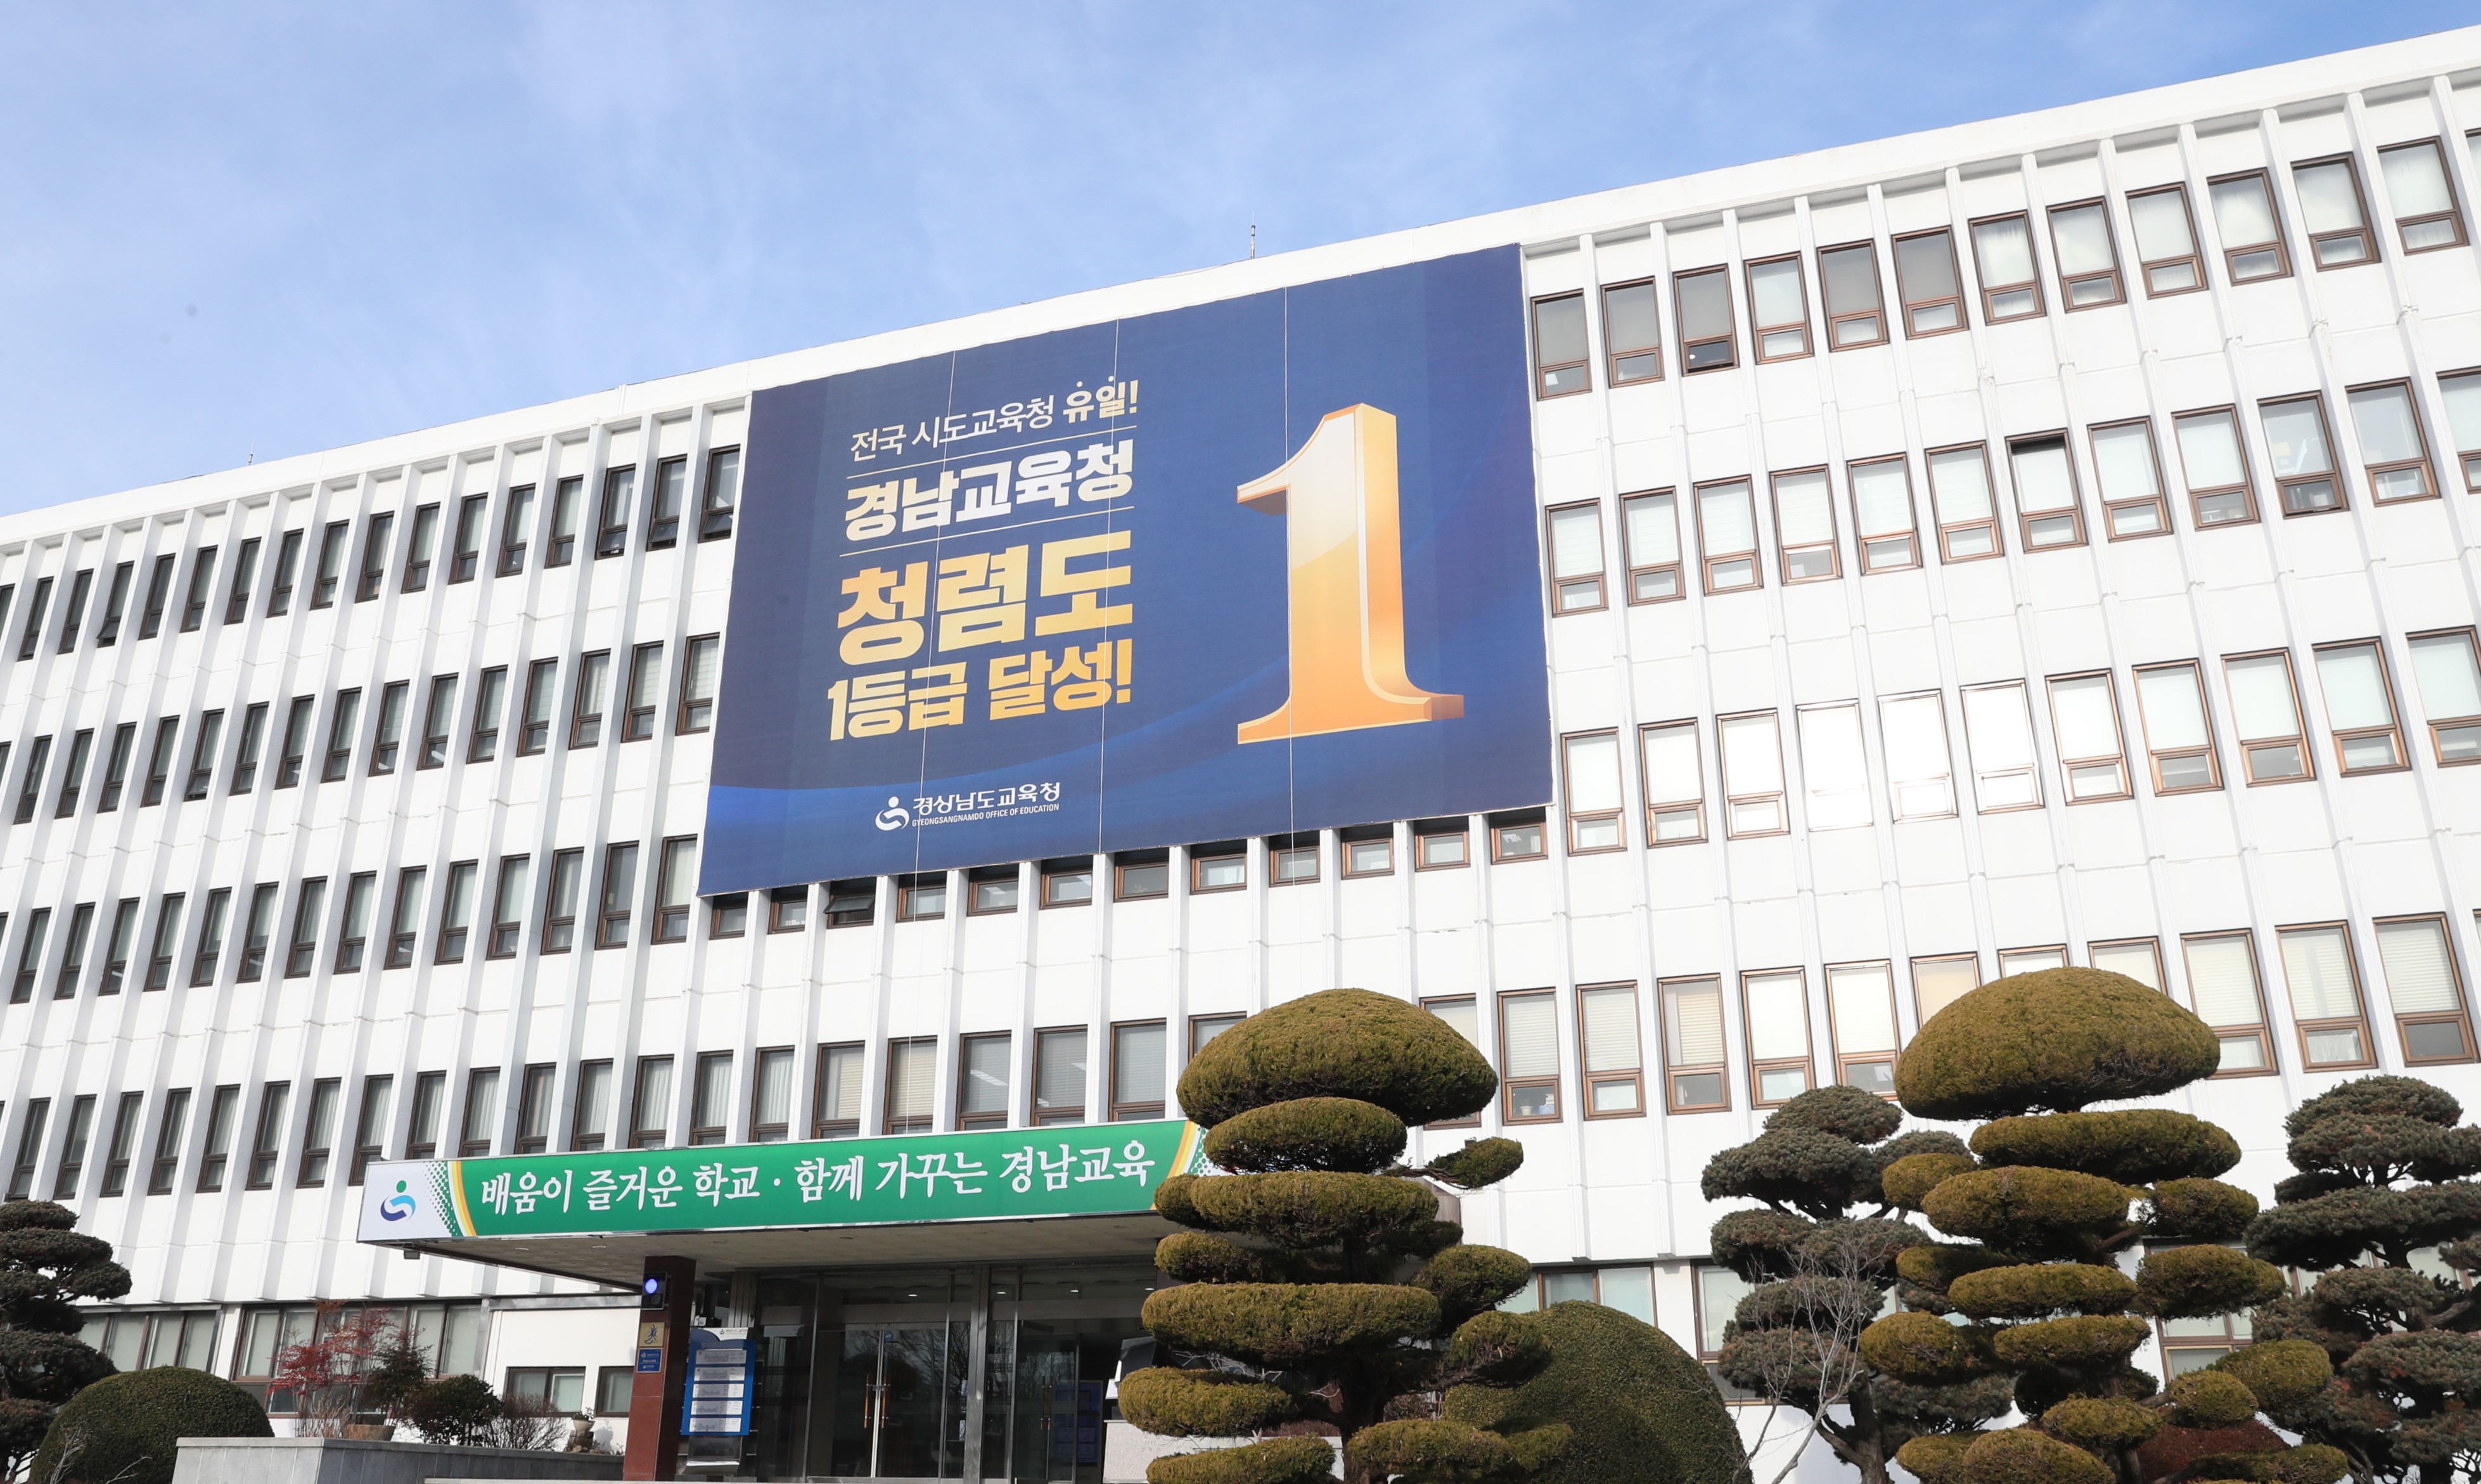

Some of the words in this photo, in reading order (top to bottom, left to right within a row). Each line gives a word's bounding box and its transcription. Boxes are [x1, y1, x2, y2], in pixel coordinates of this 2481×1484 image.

[851, 425, 906, 461] 전국
[912, 395, 1054, 449] 시도교육청
[1063, 376, 1139, 423] 유일!
[845, 439, 1133, 541] 경남교육청
[837, 530, 1133, 665] 청렴도
[1237, 402, 1464, 745] 1
[828, 662, 968, 741] 1등급
[989, 638, 1132, 720] 달성!
[912, 812, 984, 827] GYEONGSANGNAMDO
[985, 808, 1008, 819] OFFICE
[1010, 806, 1019, 816] OF
[1020, 803, 1060, 815] EDUCATION
[913, 782, 1060, 816] 경상남도교육청
[482, 1169, 574, 1215] 배움이
[582, 1165, 683, 1212] 즐거운
[693, 1162, 761, 1206] 학교
[793, 1155, 864, 1203] 함께
[875, 1152, 989, 1199] 가꾸는
[999, 1139, 1156, 1193] 경남교육
